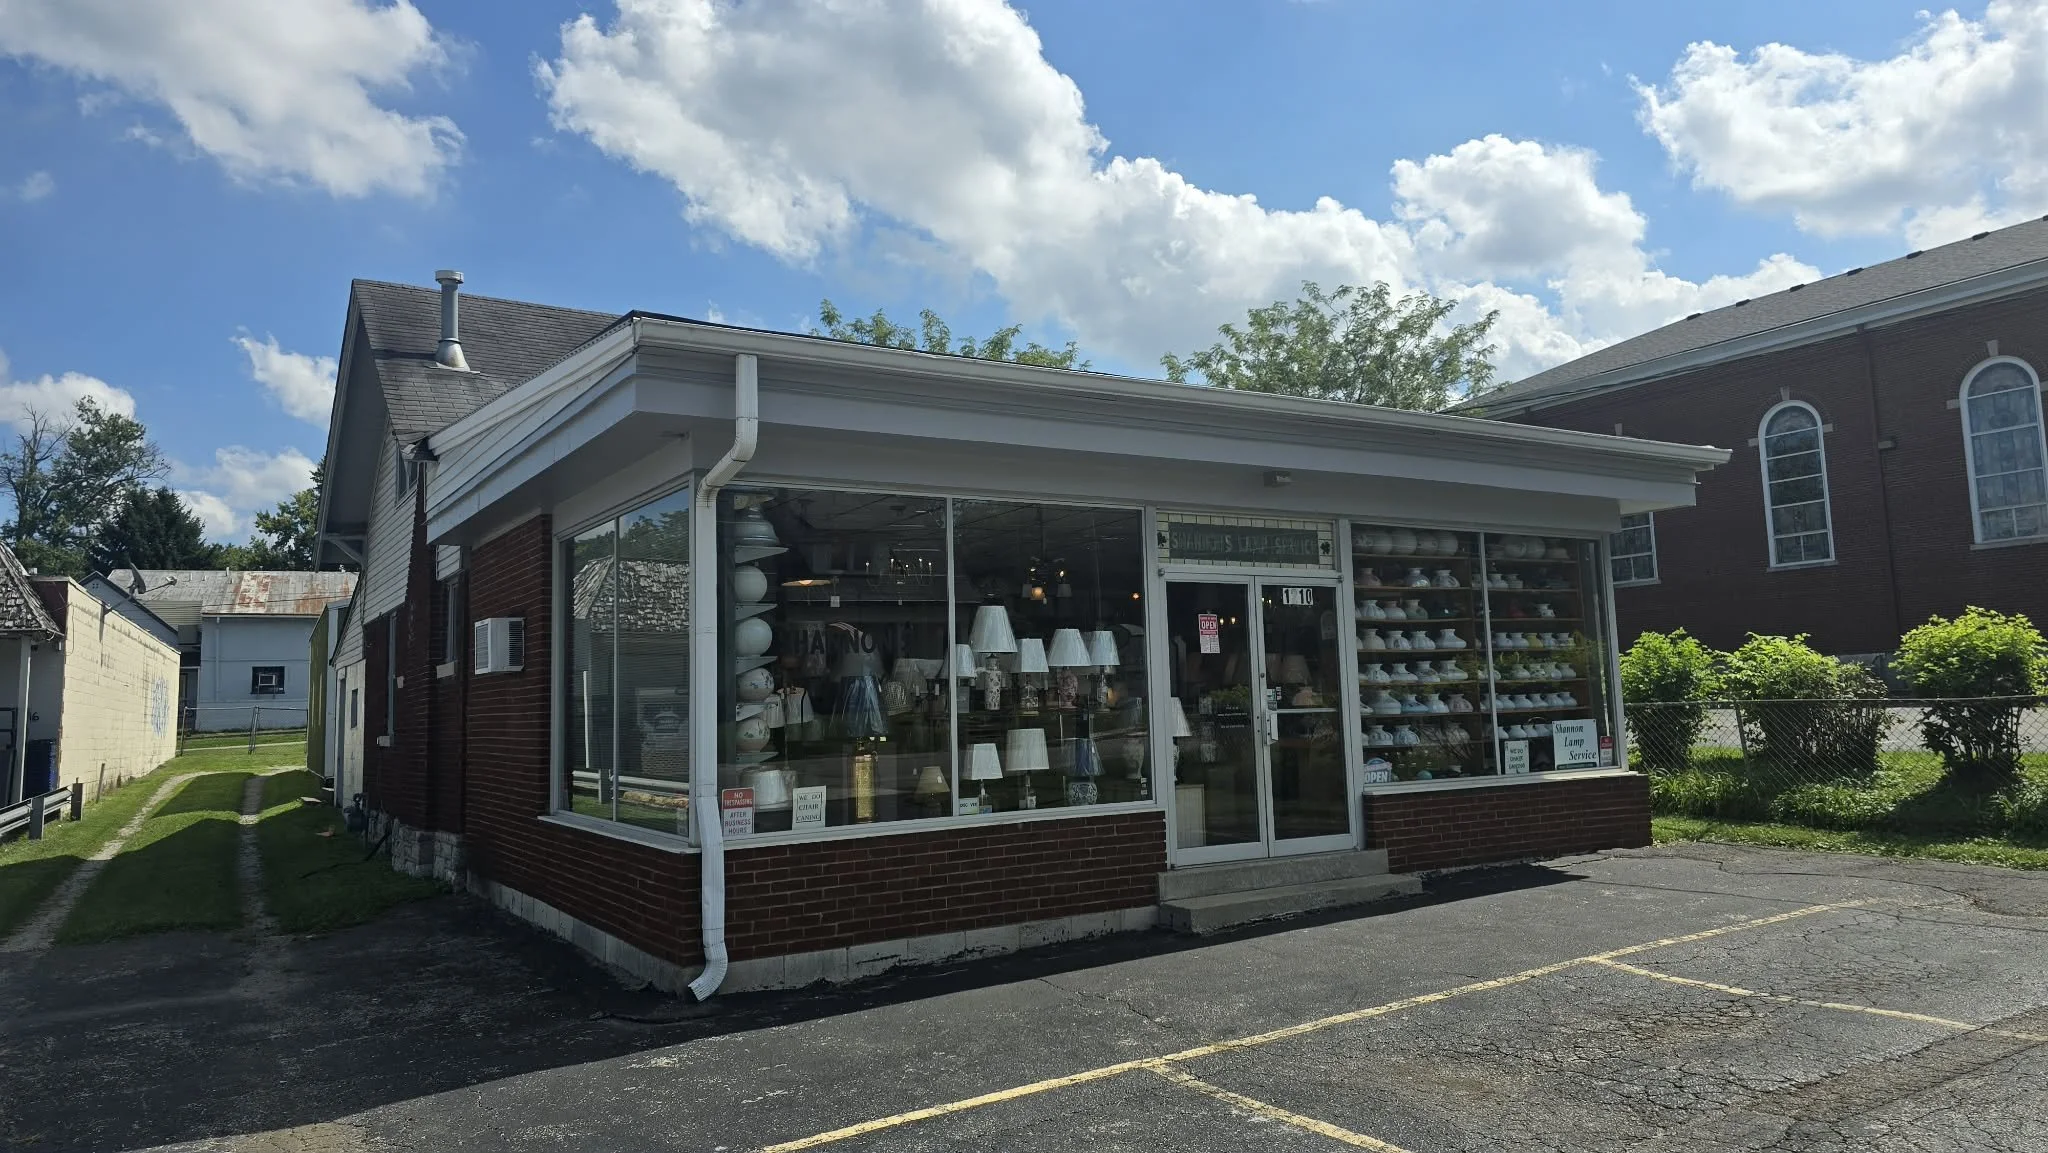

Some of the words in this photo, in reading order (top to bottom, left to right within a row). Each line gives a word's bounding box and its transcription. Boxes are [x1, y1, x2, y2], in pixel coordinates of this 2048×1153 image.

[1201, 620, 1217, 629] OPEN
[1555, 723, 1584, 734] Shannon
[1564, 737, 1585, 748] Lamp
[1568, 749, 1597, 761] Service
[1365, 770, 1388, 784] OPEN
[724, 798, 753, 807] TRESPASSING
[798, 803, 819, 811] CHAIR
[724, 818, 752, 827] BUSINESS
[728, 826, 748, 835] HOURS
